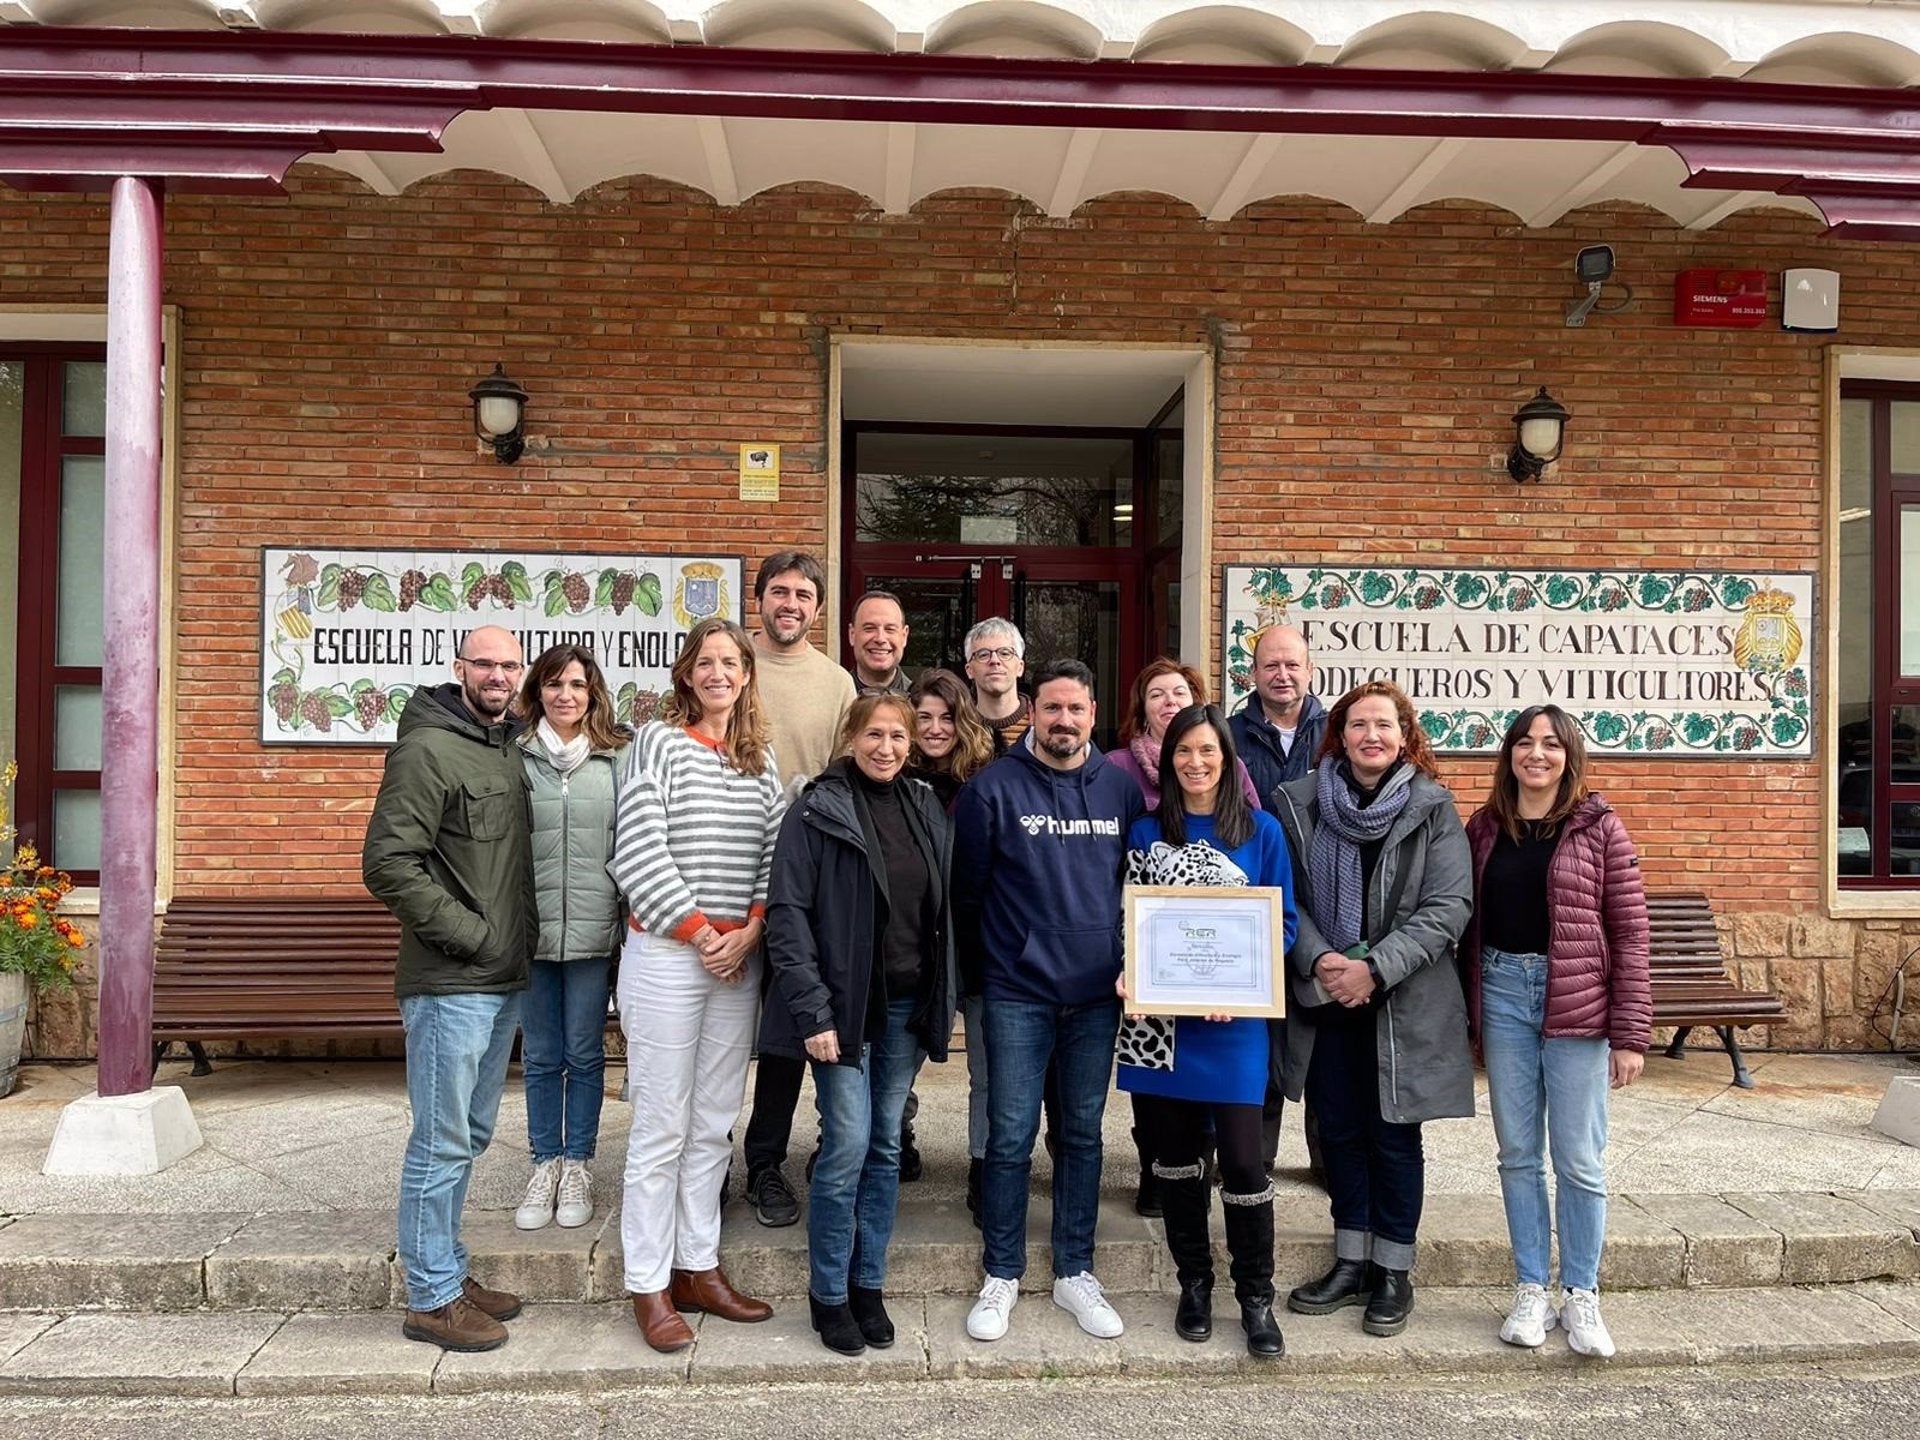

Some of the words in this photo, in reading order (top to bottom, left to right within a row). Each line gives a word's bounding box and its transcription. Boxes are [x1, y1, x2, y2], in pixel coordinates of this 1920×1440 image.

[1693, 295, 1728, 303] SIEMENS
[314, 628, 412, 665] ESCUELA
[421, 628, 445, 666] DE
[601, 631, 613, 668] Y
[618, 631, 688, 668] ENOLO
[1302, 620, 1472, 653] ESCUELA
[1484, 623, 1529, 654] DE
[1539, 624, 1735, 656] CAPATACES
[1308, 667, 1493, 699] ODEUEROS
[1503, 669, 1527, 699] Y
[1537, 669, 1774, 701] VITICULTORES
[1047, 815, 1119, 835] hummel
